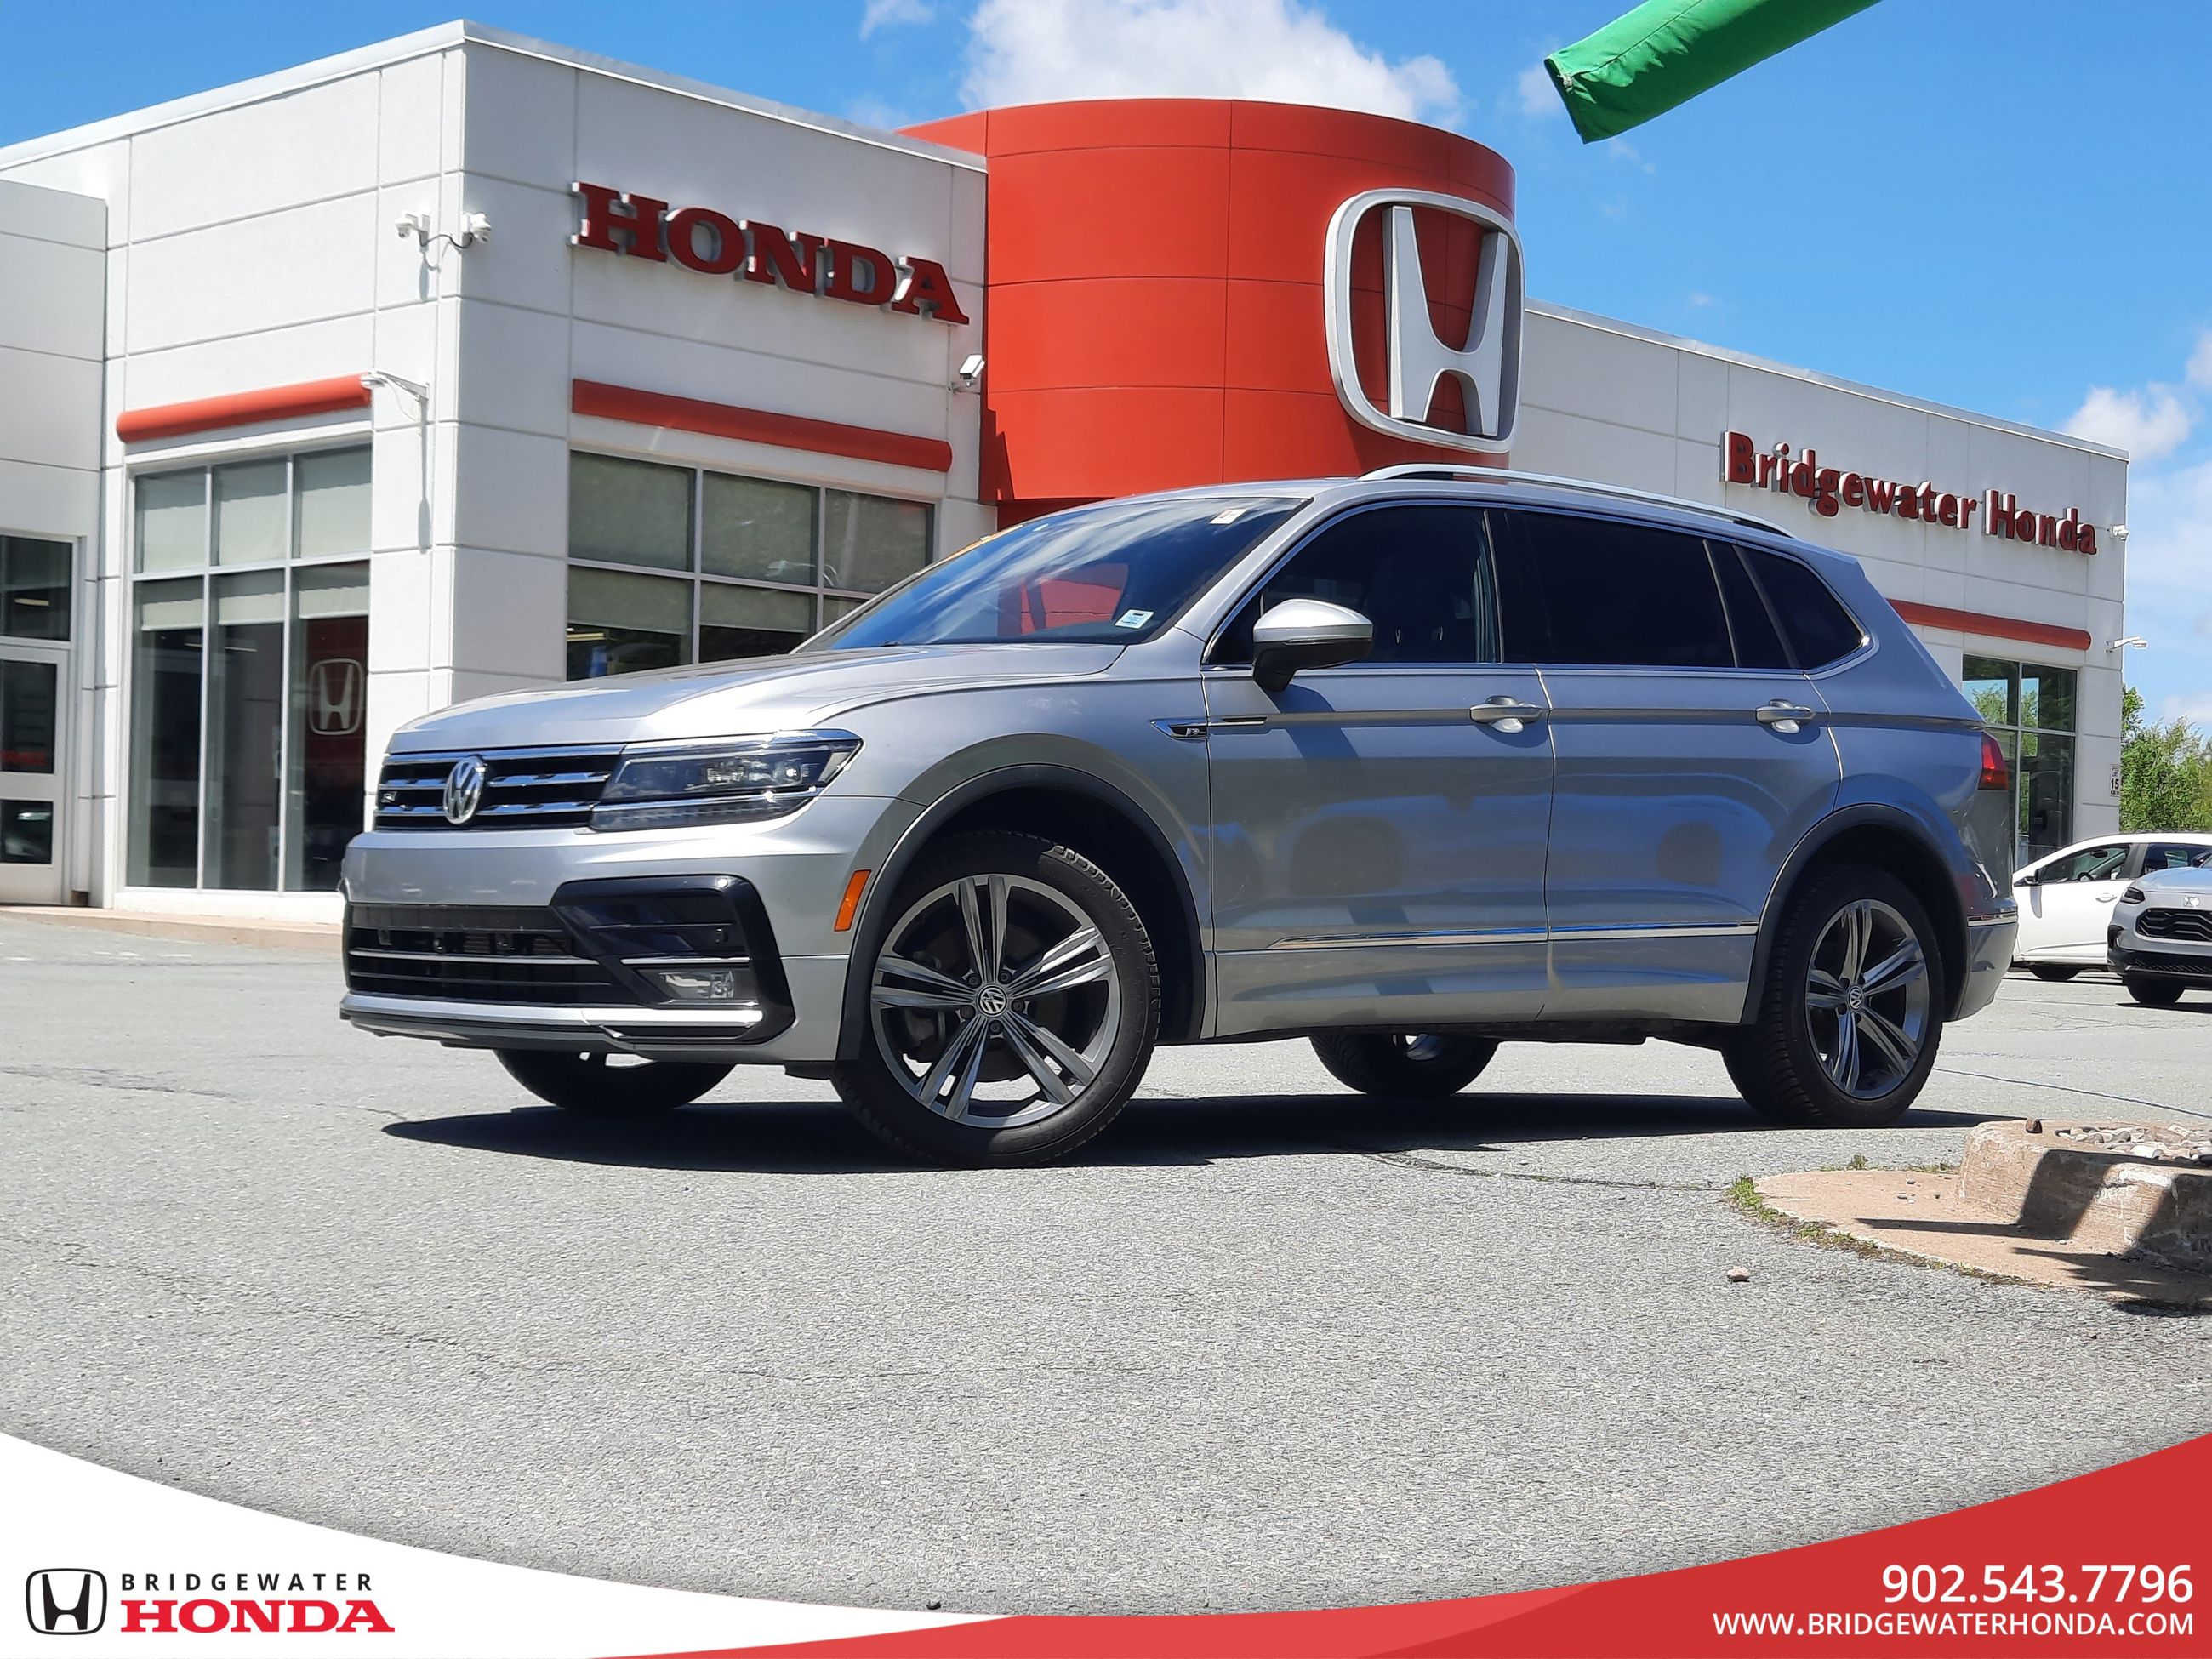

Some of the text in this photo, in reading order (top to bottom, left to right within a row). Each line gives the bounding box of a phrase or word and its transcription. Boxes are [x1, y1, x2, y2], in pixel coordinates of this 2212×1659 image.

[570, 180, 969, 325] HONDA
[1723, 430, 2097, 555] Bridgewater Honda
